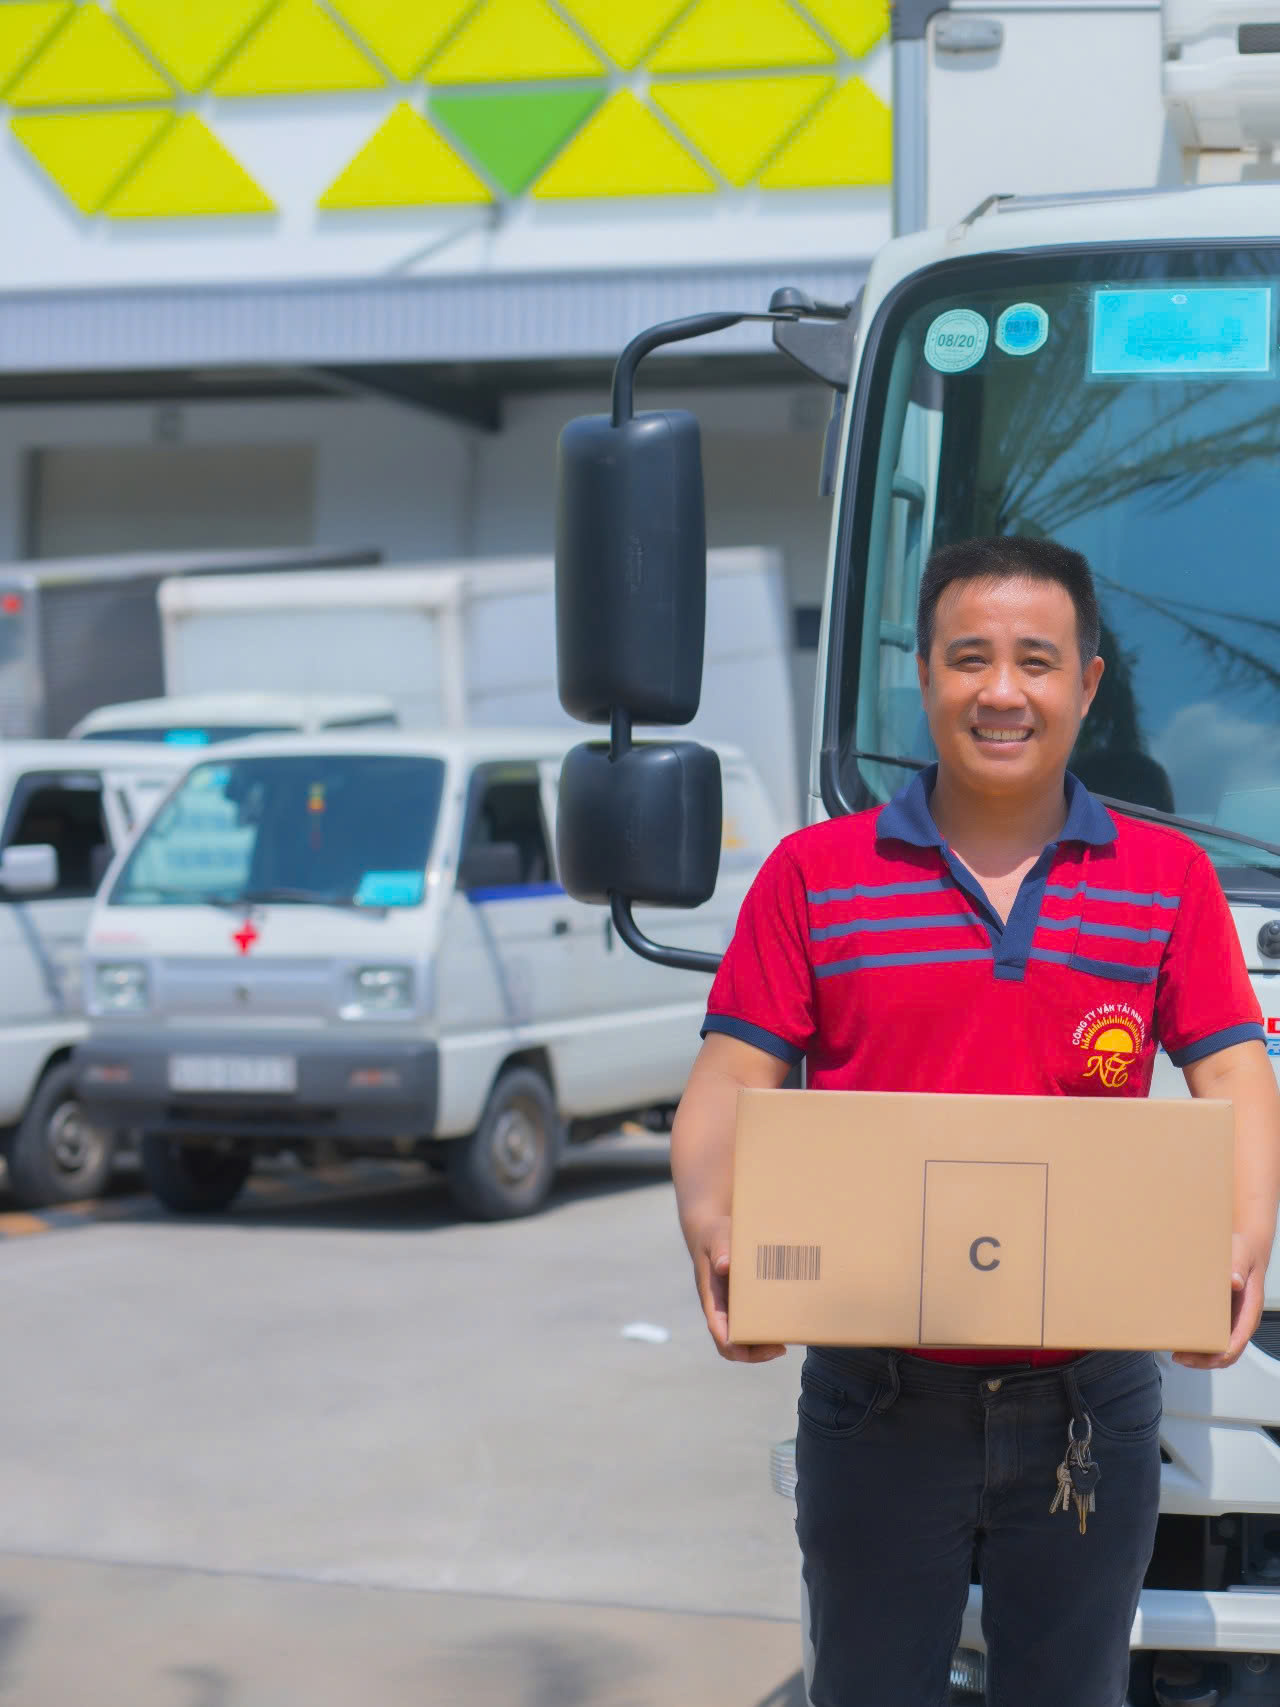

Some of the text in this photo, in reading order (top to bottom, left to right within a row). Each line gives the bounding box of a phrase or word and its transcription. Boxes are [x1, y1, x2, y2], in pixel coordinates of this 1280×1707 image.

[937, 333, 975, 348] 08/20
[1085, 1010, 1097, 1022] TY
[968, 1235, 1001, 1272] C
